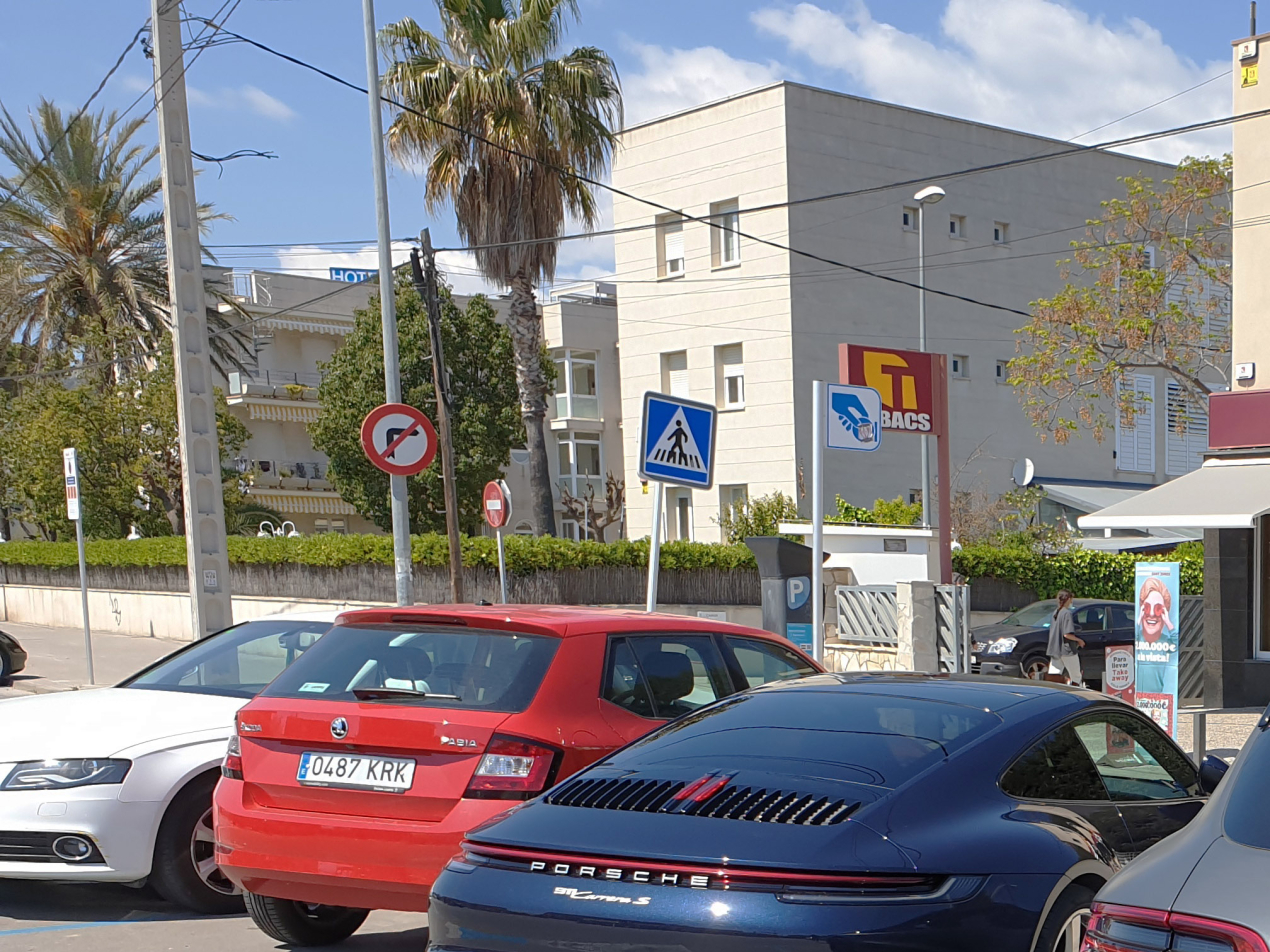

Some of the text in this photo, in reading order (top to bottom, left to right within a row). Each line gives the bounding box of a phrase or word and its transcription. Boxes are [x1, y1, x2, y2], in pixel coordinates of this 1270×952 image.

[790, 579, 804, 603] P
[312, 756, 409, 783] 0487 KRK
[530, 861, 709, 887] PORSCHE
